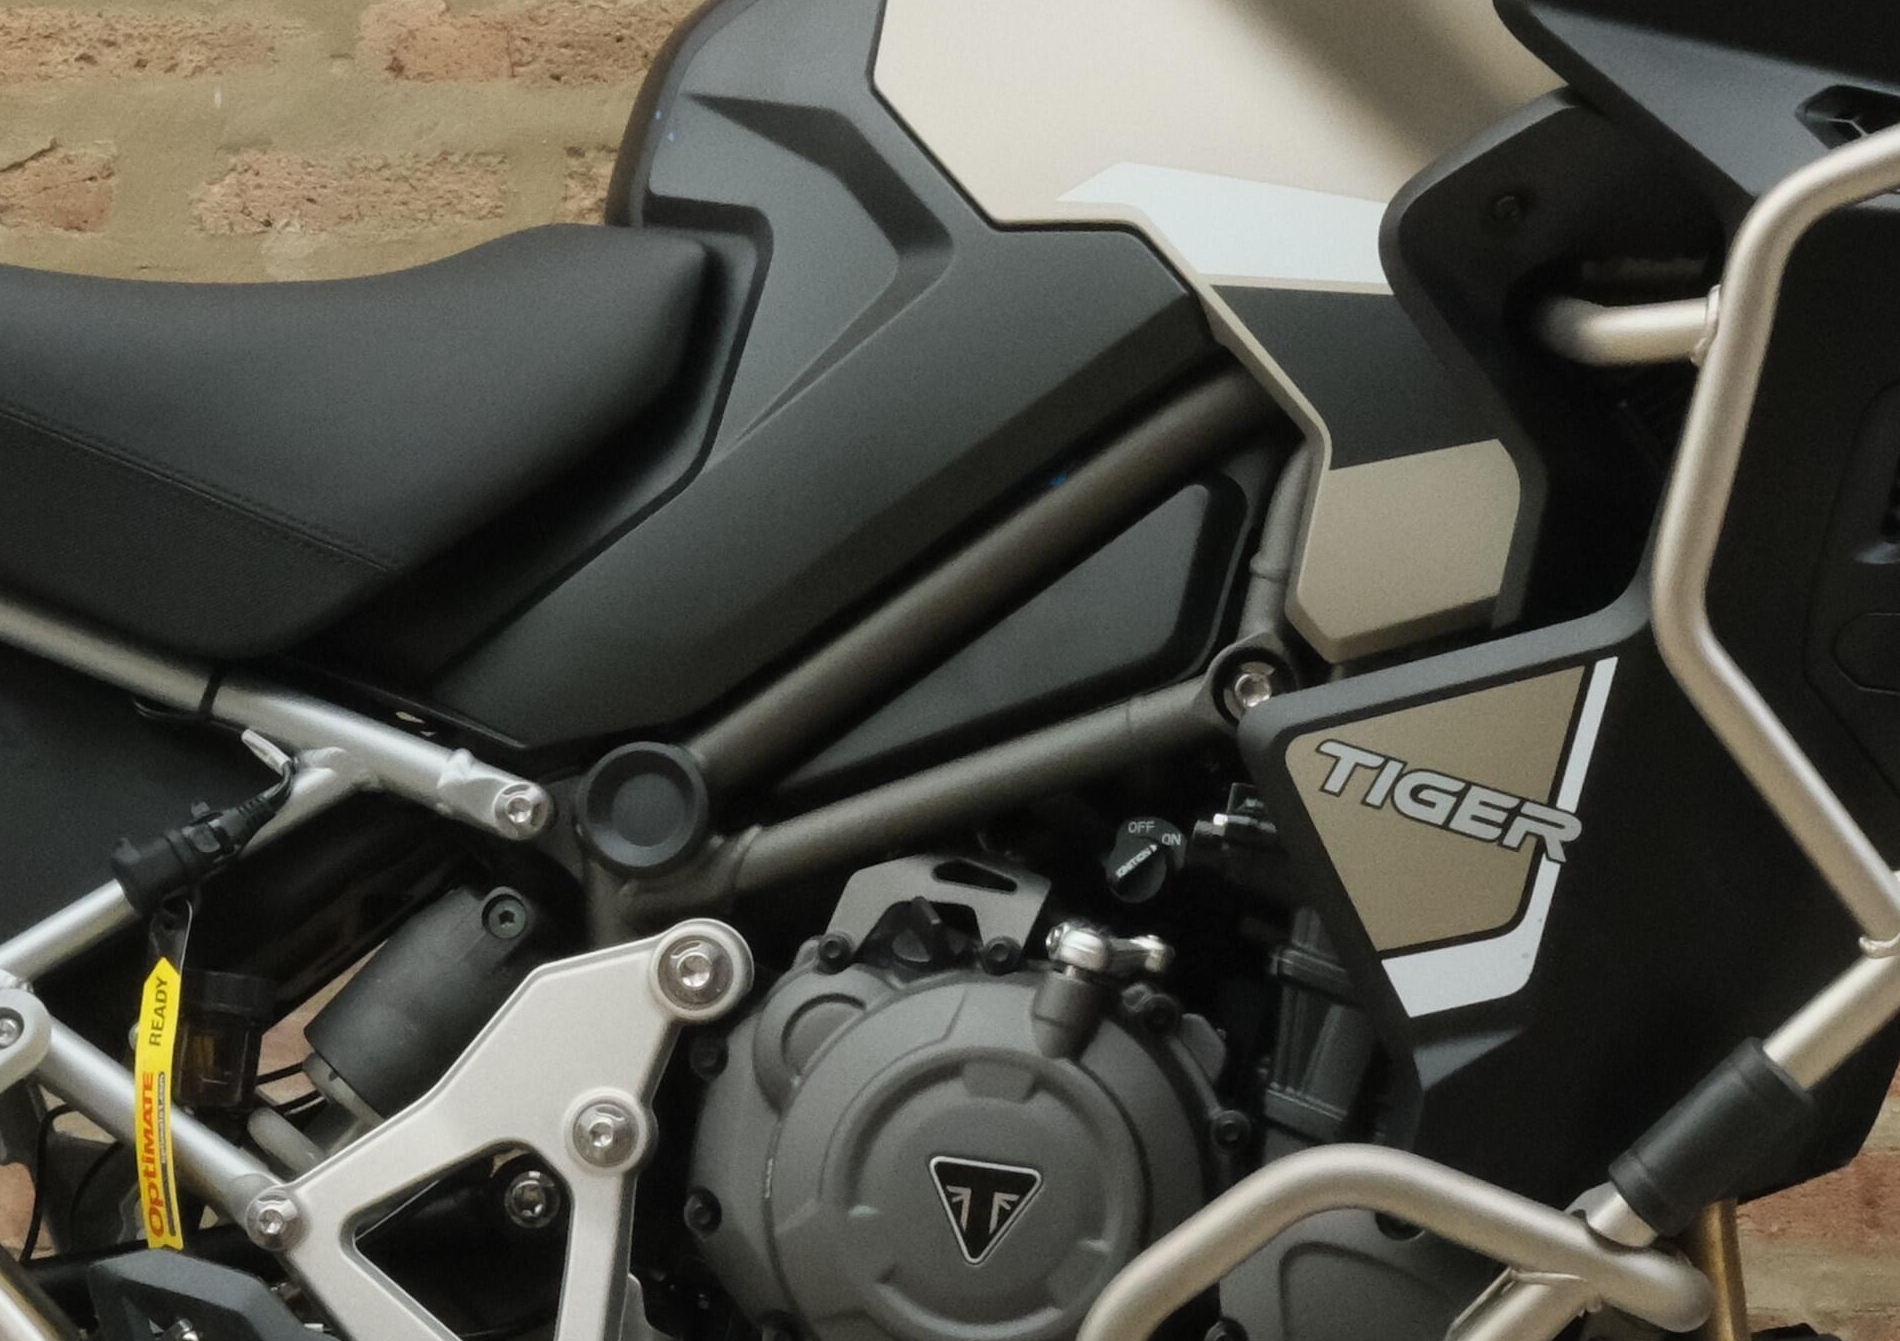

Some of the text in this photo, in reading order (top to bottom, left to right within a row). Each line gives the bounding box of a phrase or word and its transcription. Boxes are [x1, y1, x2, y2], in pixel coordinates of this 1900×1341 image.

[1316, 739, 1582, 862] TIGER
[1128, 821, 1155, 833] OFF
[1161, 833, 1181, 845] ON
[149, 976, 169, 1046] READY
